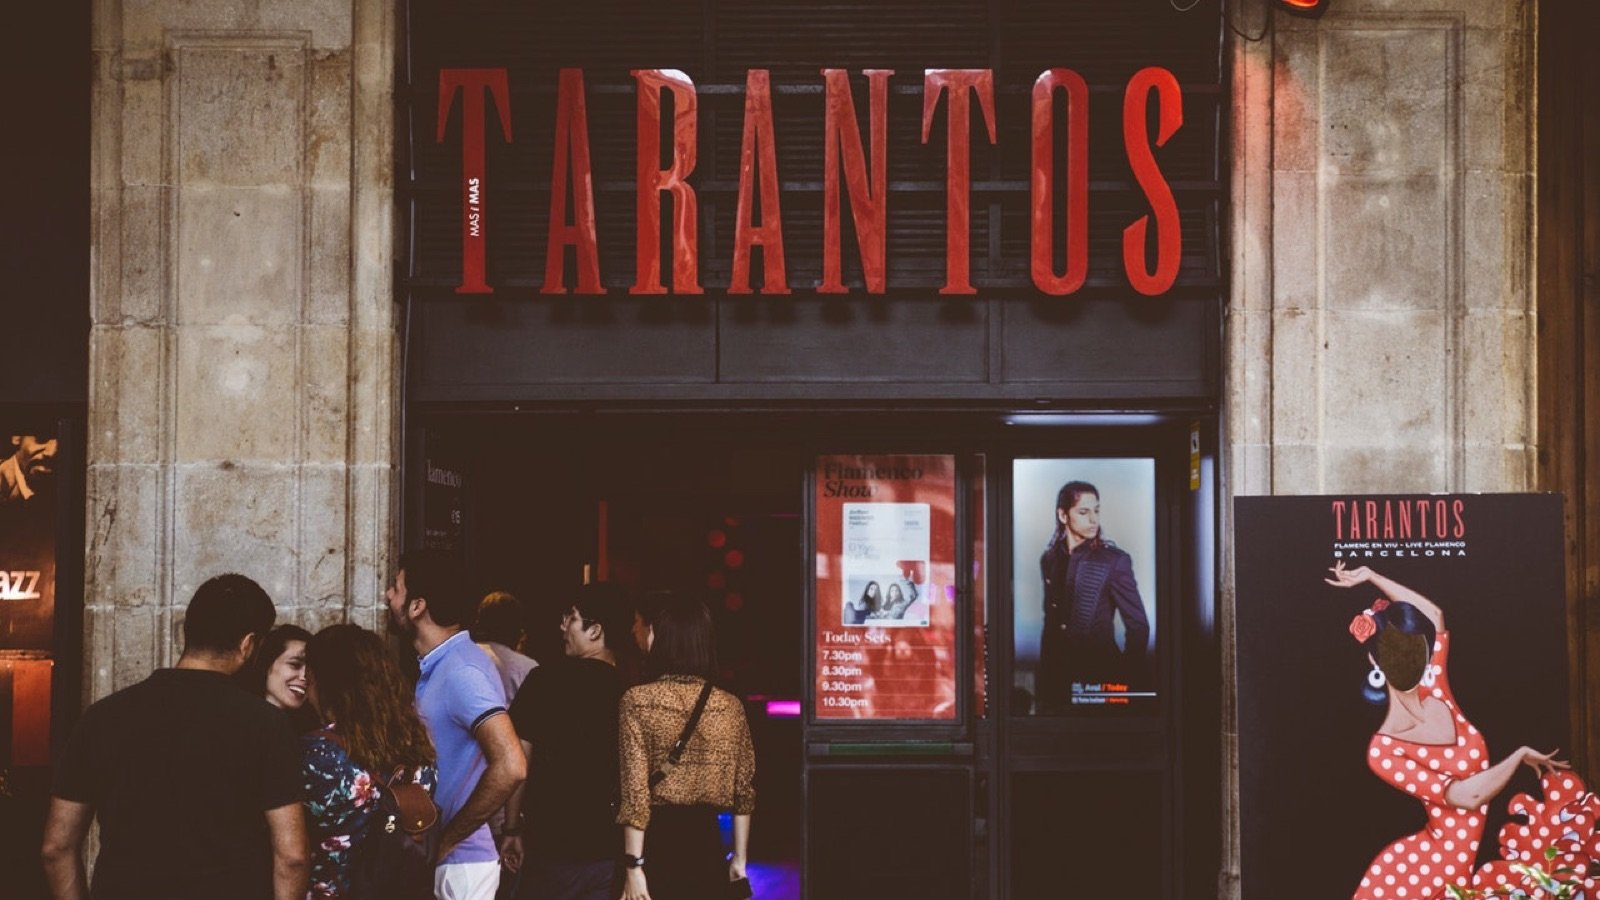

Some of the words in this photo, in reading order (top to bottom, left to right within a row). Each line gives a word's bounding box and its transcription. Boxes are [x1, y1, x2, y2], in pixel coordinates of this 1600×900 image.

[436, 66, 1184, 296] TARANTOS
[468, 178, 480, 205] MAS
[469, 213, 480, 237] MAS
[824, 462, 923, 480] Flamenco
[824, 479, 879, 498] Show
[1331, 499, 1466, 540] TARANTOS
[1333, 549, 1467, 558] BARCELONA
[823, 630, 861, 646] Today
[864, 630, 892, 644] Sets
[822, 650, 863, 662] 7.30pm
[822, 665, 862, 678] 8.30pm
[822, 680, 862, 693] 9.30pm
[823, 696, 869, 709] 10.30pm
